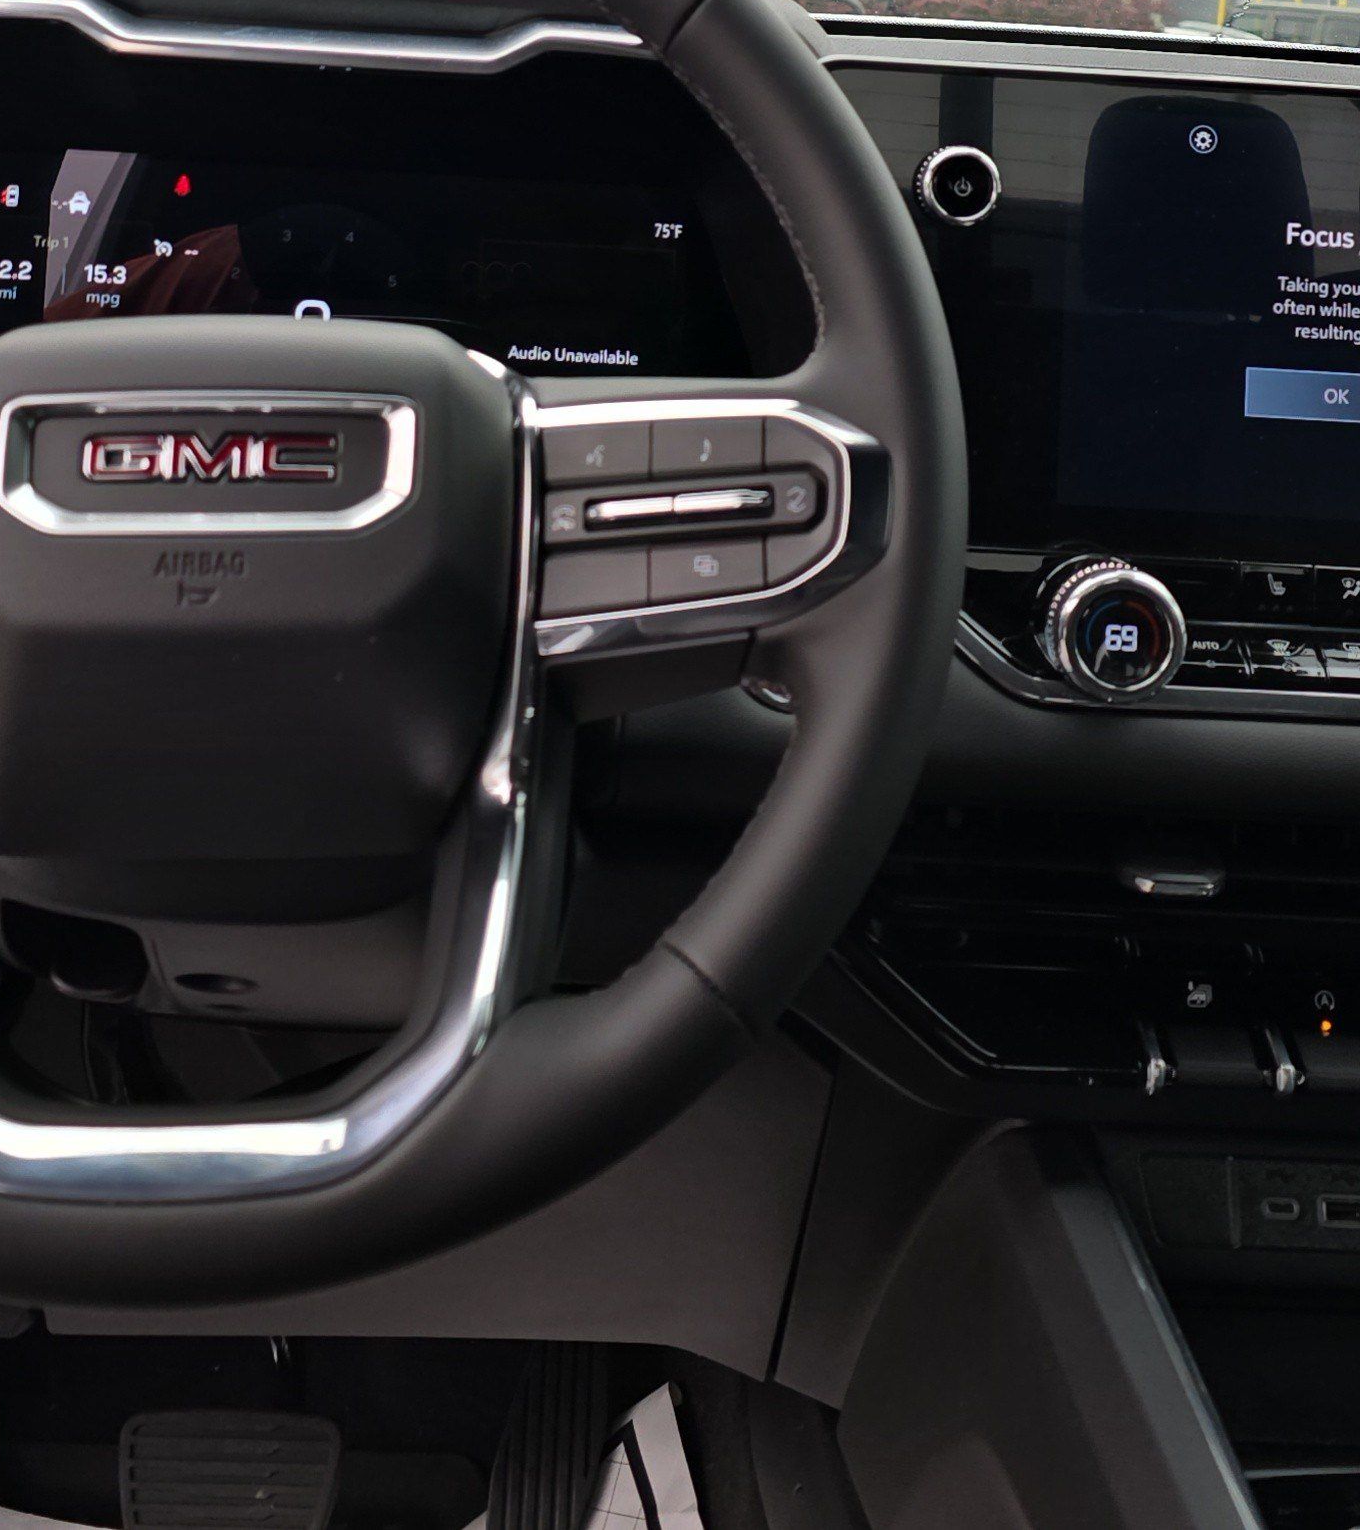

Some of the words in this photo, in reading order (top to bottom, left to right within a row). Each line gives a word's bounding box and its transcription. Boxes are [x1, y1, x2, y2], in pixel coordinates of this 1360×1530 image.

[32, 233, 61, 251] Trip
[62, 235, 71, 250] 1
[653, 222, 684, 240] 75°F
[1285, 222, 1355, 251] Focus
[83, 264, 127, 285] 15.3
[1277, 275, 1330, 299] Taking
[85, 290, 121, 309] mpg
[1272, 299, 1316, 318] often
[1319, 302, 1360, 320] while
[506, 343, 552, 362] Audio
[553, 346, 640, 367] Unavailable
[1323, 387, 1351, 406] OK
[82, 432, 338, 482] GMC
[153, 549, 245, 578] AIRBAG
[1103, 624, 1140, 653] 69
